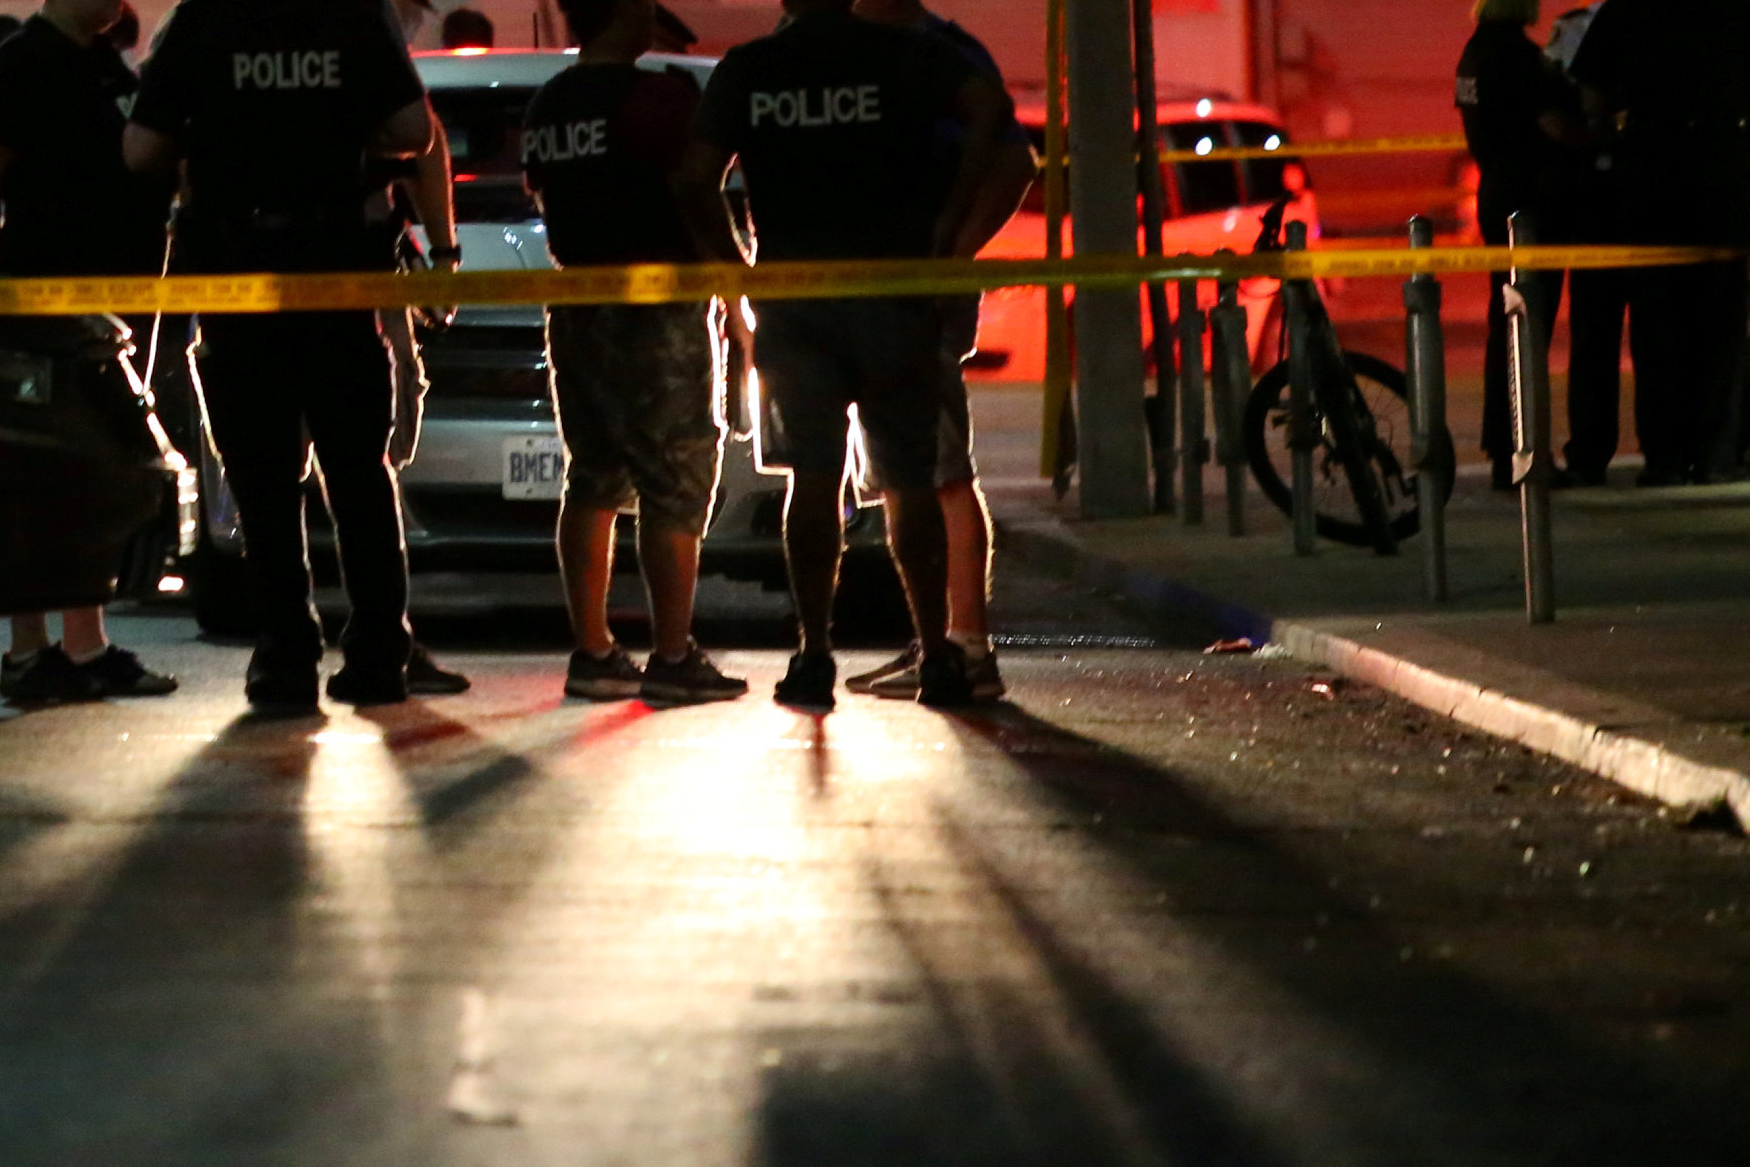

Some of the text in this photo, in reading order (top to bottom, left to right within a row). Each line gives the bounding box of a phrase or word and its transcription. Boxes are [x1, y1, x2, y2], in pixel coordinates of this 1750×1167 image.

[234, 50, 340, 89] POLICE
[750, 85, 881, 128] POLICE
[520, 117, 608, 164] POLICE
